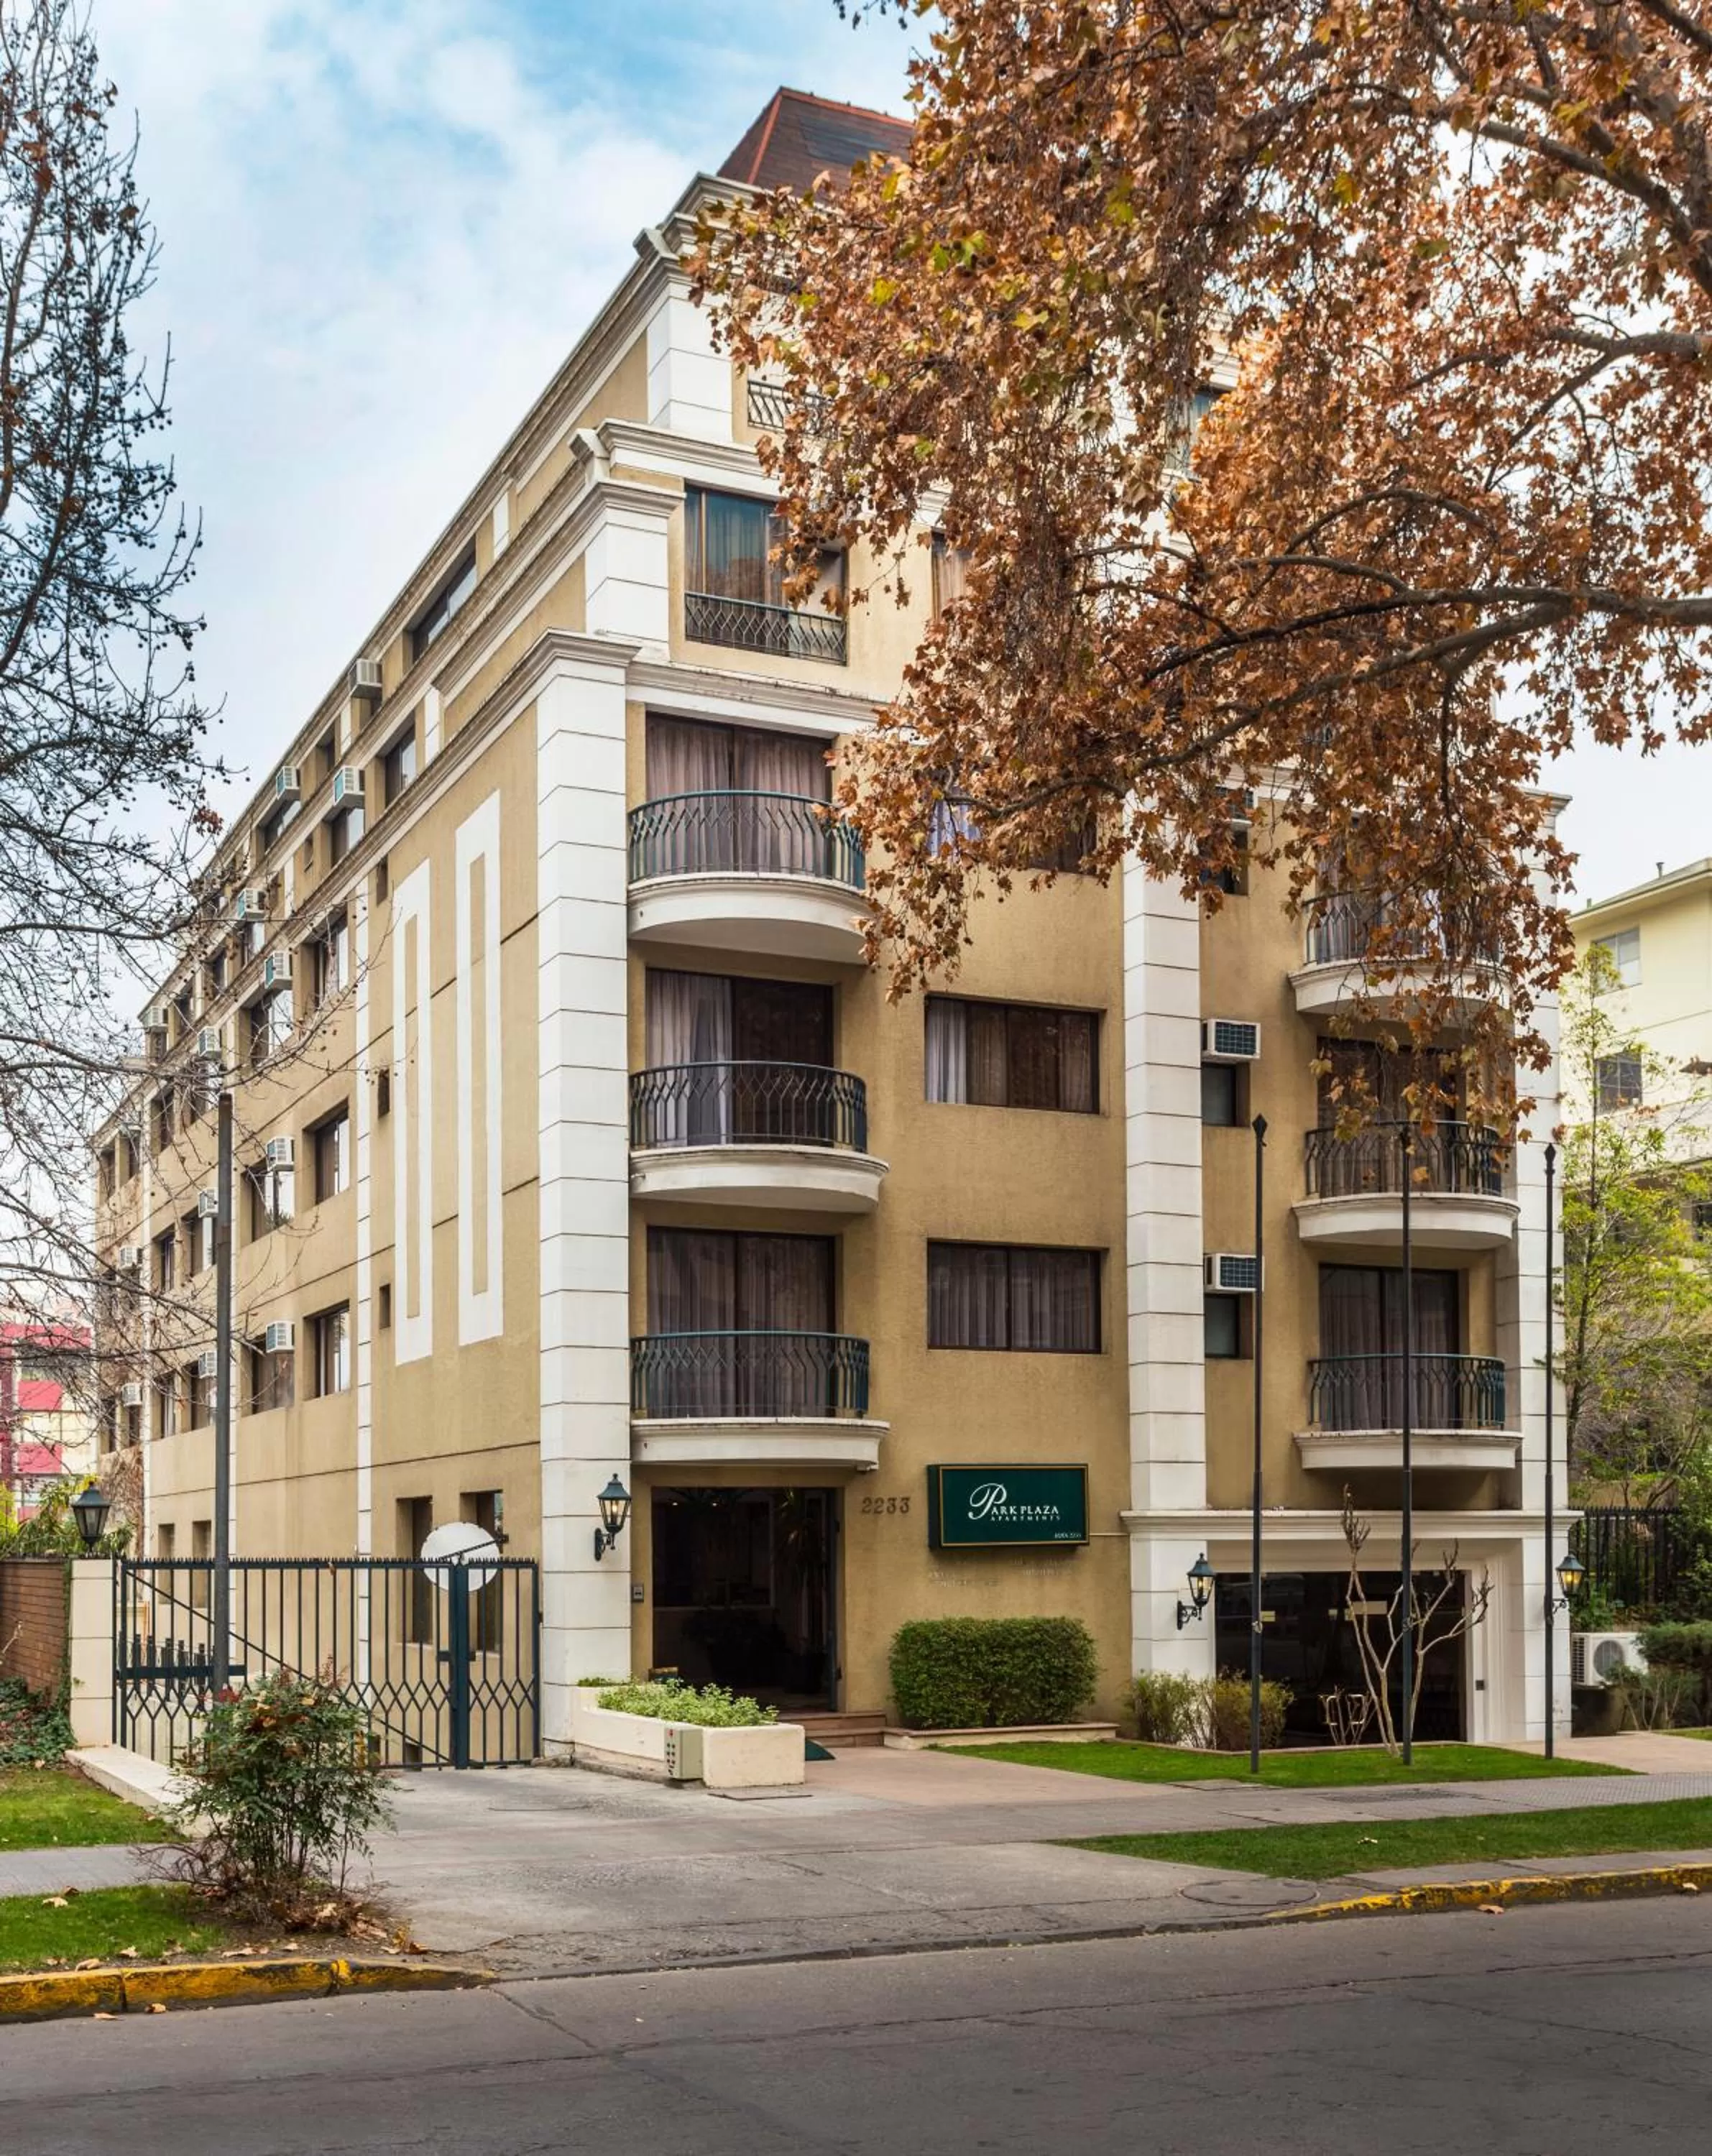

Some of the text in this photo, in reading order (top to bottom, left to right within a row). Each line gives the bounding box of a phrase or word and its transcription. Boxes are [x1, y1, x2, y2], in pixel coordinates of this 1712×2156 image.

[862, 1496, 911, 1514] 2233
[968, 1483, 1059, 1520] PARK PLAZA
